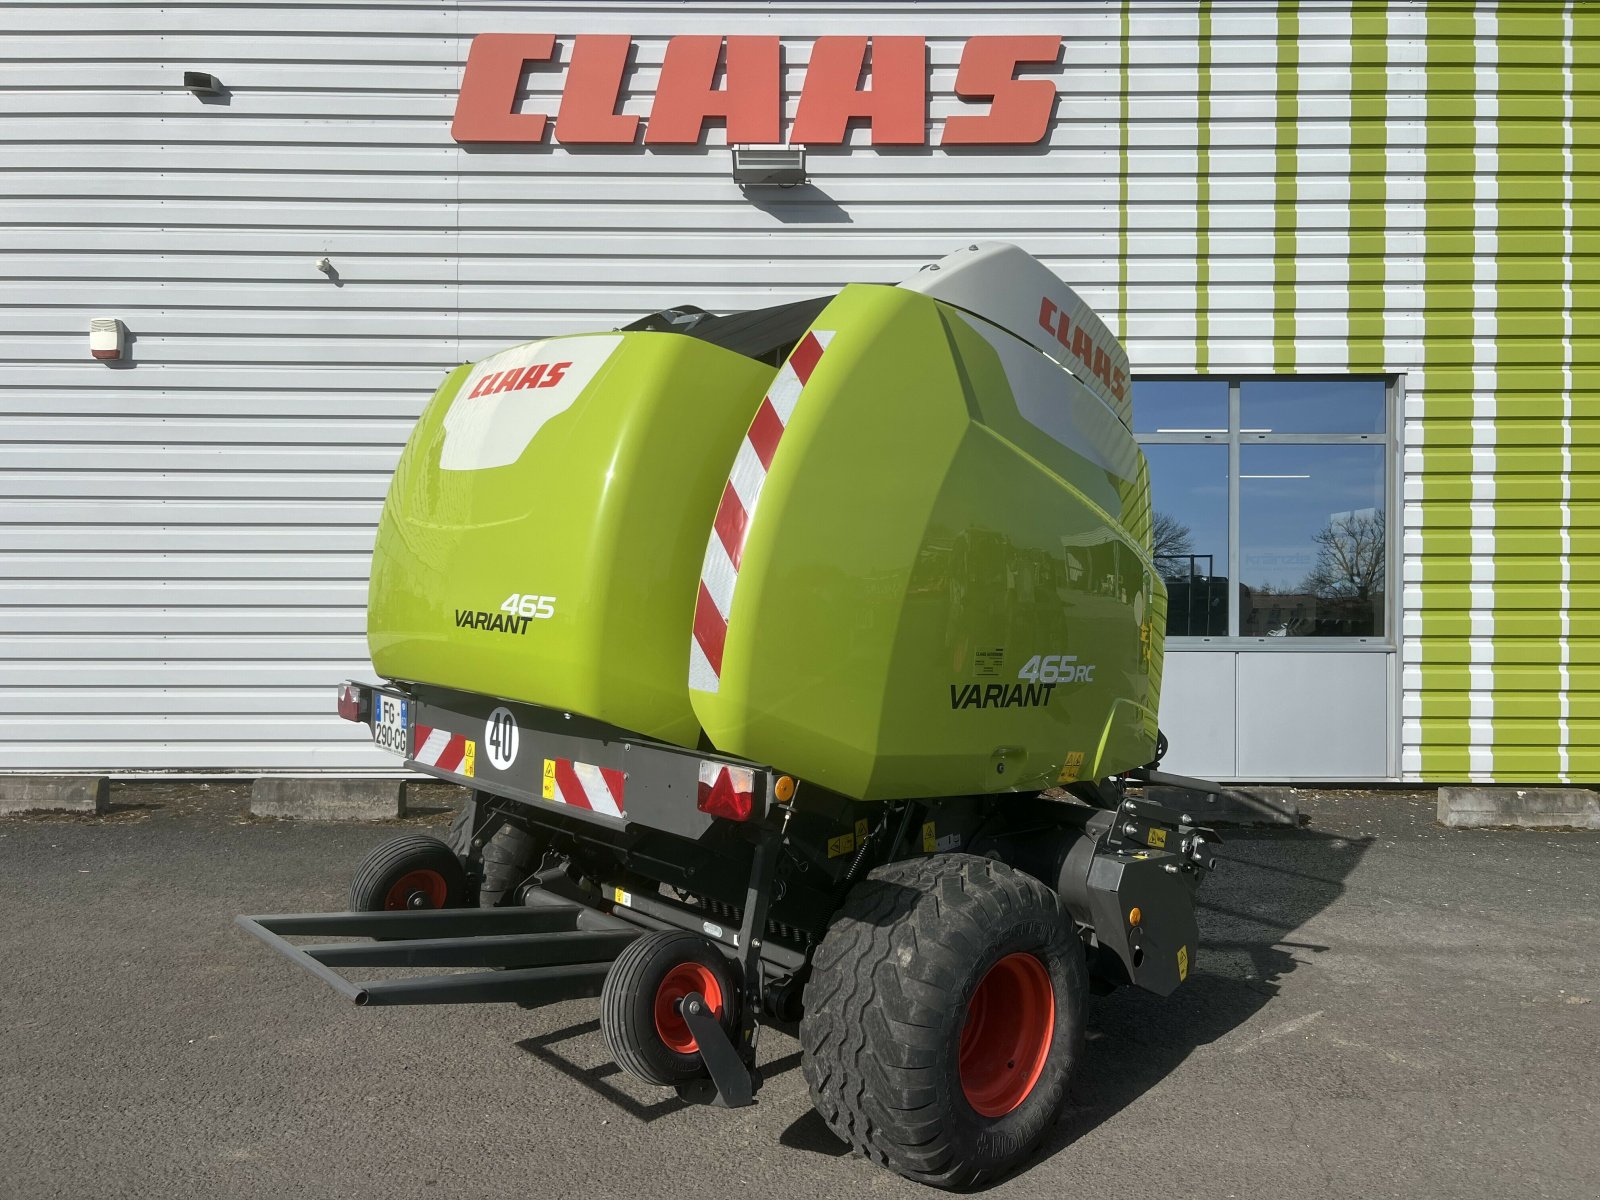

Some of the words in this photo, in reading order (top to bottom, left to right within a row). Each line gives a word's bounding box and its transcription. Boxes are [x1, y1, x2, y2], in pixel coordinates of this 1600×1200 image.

[451, 34, 1062, 145] CLAAS
[1039, 296, 1125, 402] CLAAS
[468, 361, 573, 399] CLAAS
[455, 609, 533, 635] VARIANT
[500, 594, 556, 619] 465
[950, 683, 1057, 709] VARIANT
[376, 723, 406, 751] 290-CG
[490, 712, 514, 764] 40
